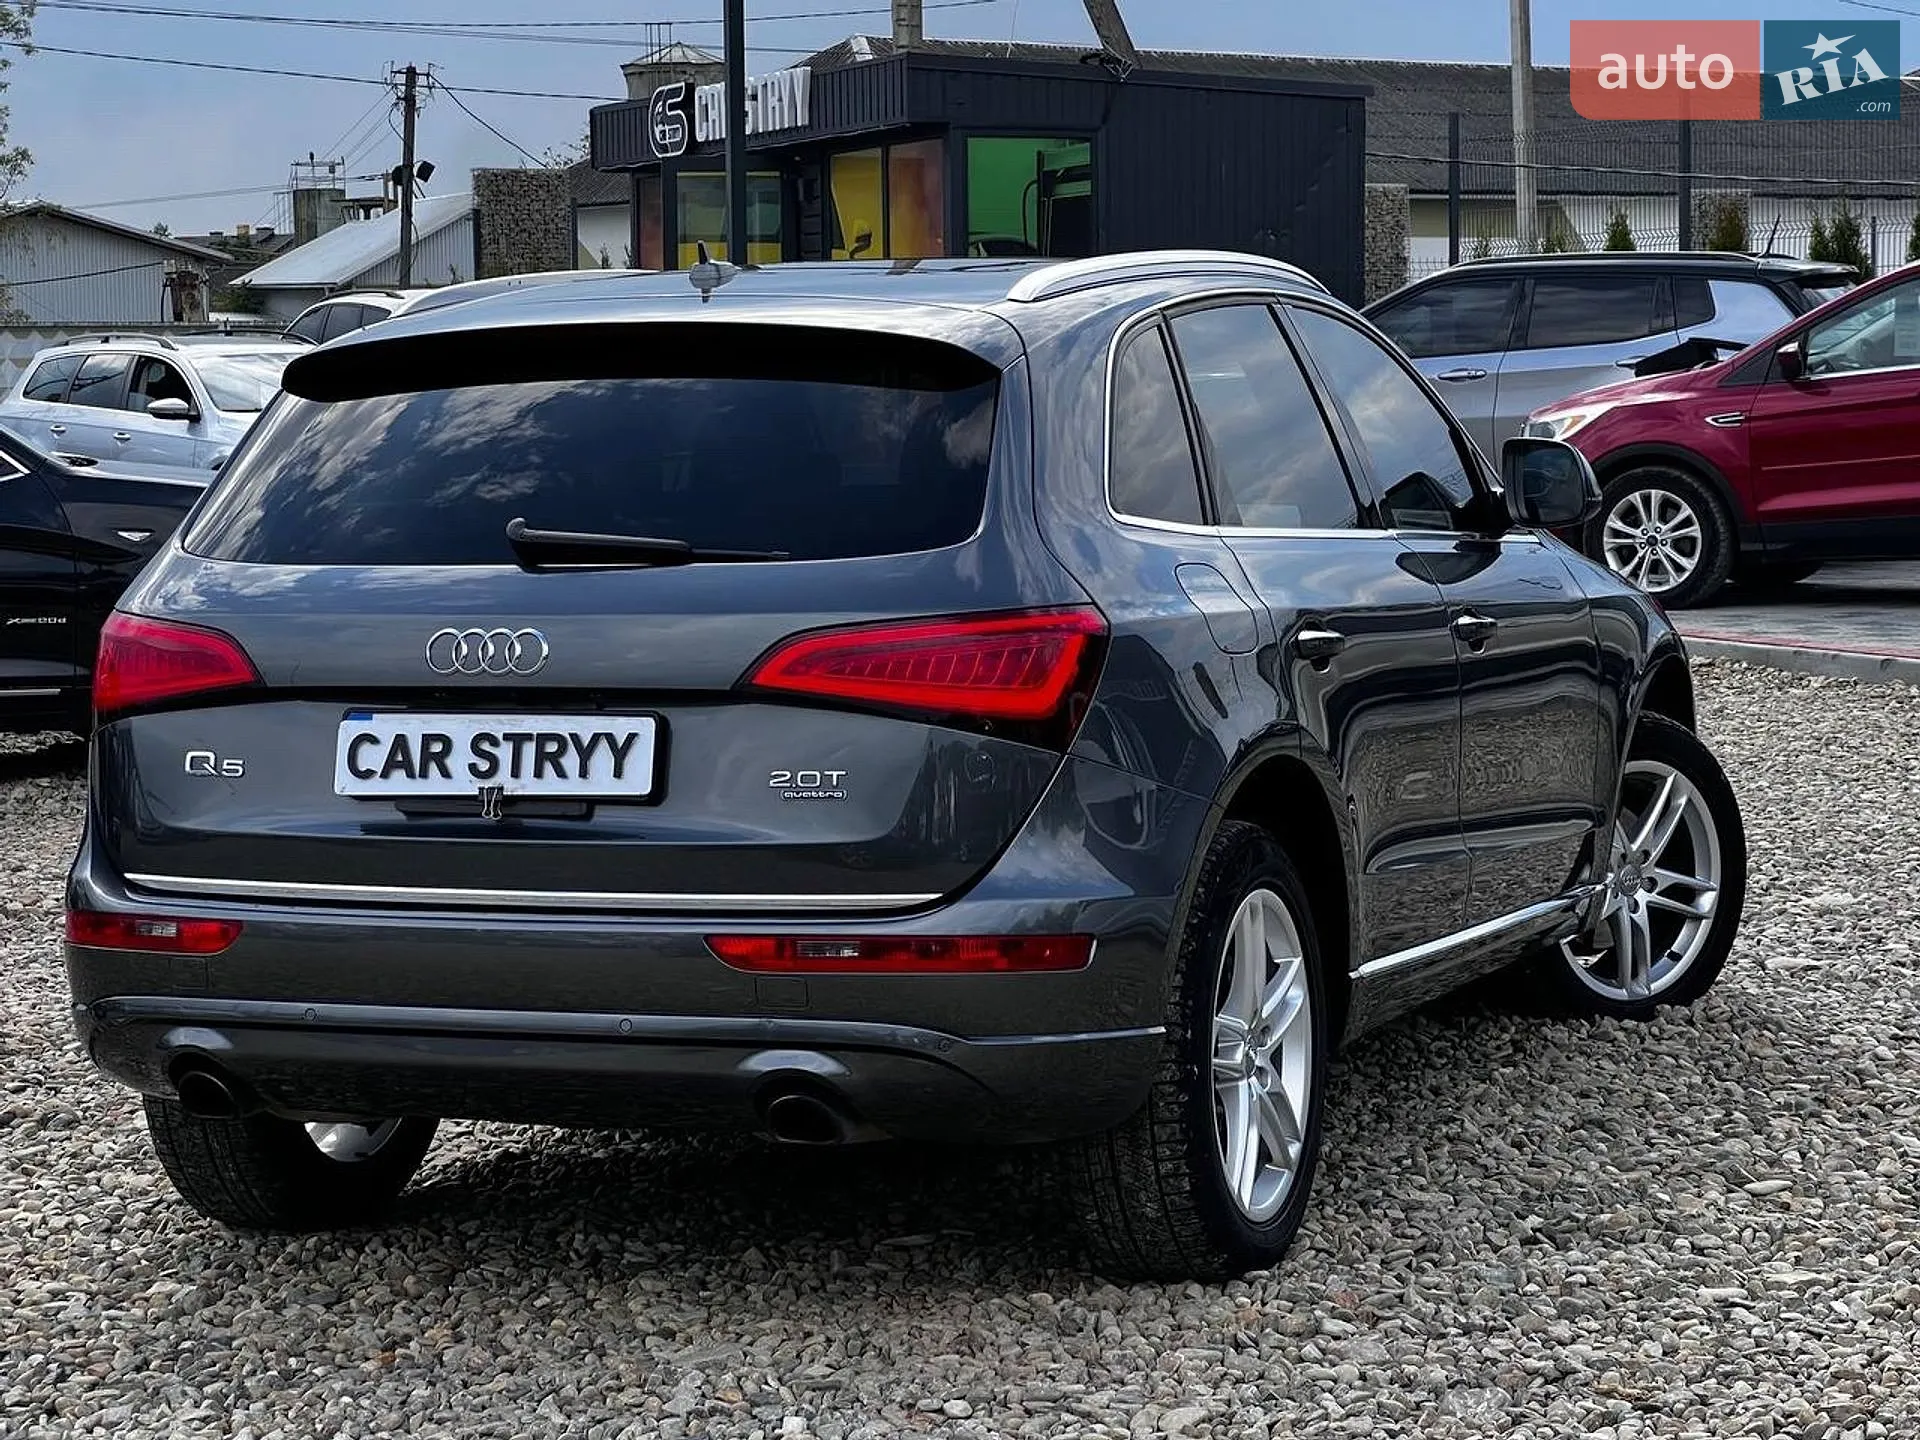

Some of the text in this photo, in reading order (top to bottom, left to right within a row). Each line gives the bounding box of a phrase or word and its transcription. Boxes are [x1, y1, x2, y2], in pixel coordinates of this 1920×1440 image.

[185, 751, 245, 777] Q5
[347, 731, 638, 780] CAR STRYY
[769, 770, 846, 788] 2.0T
